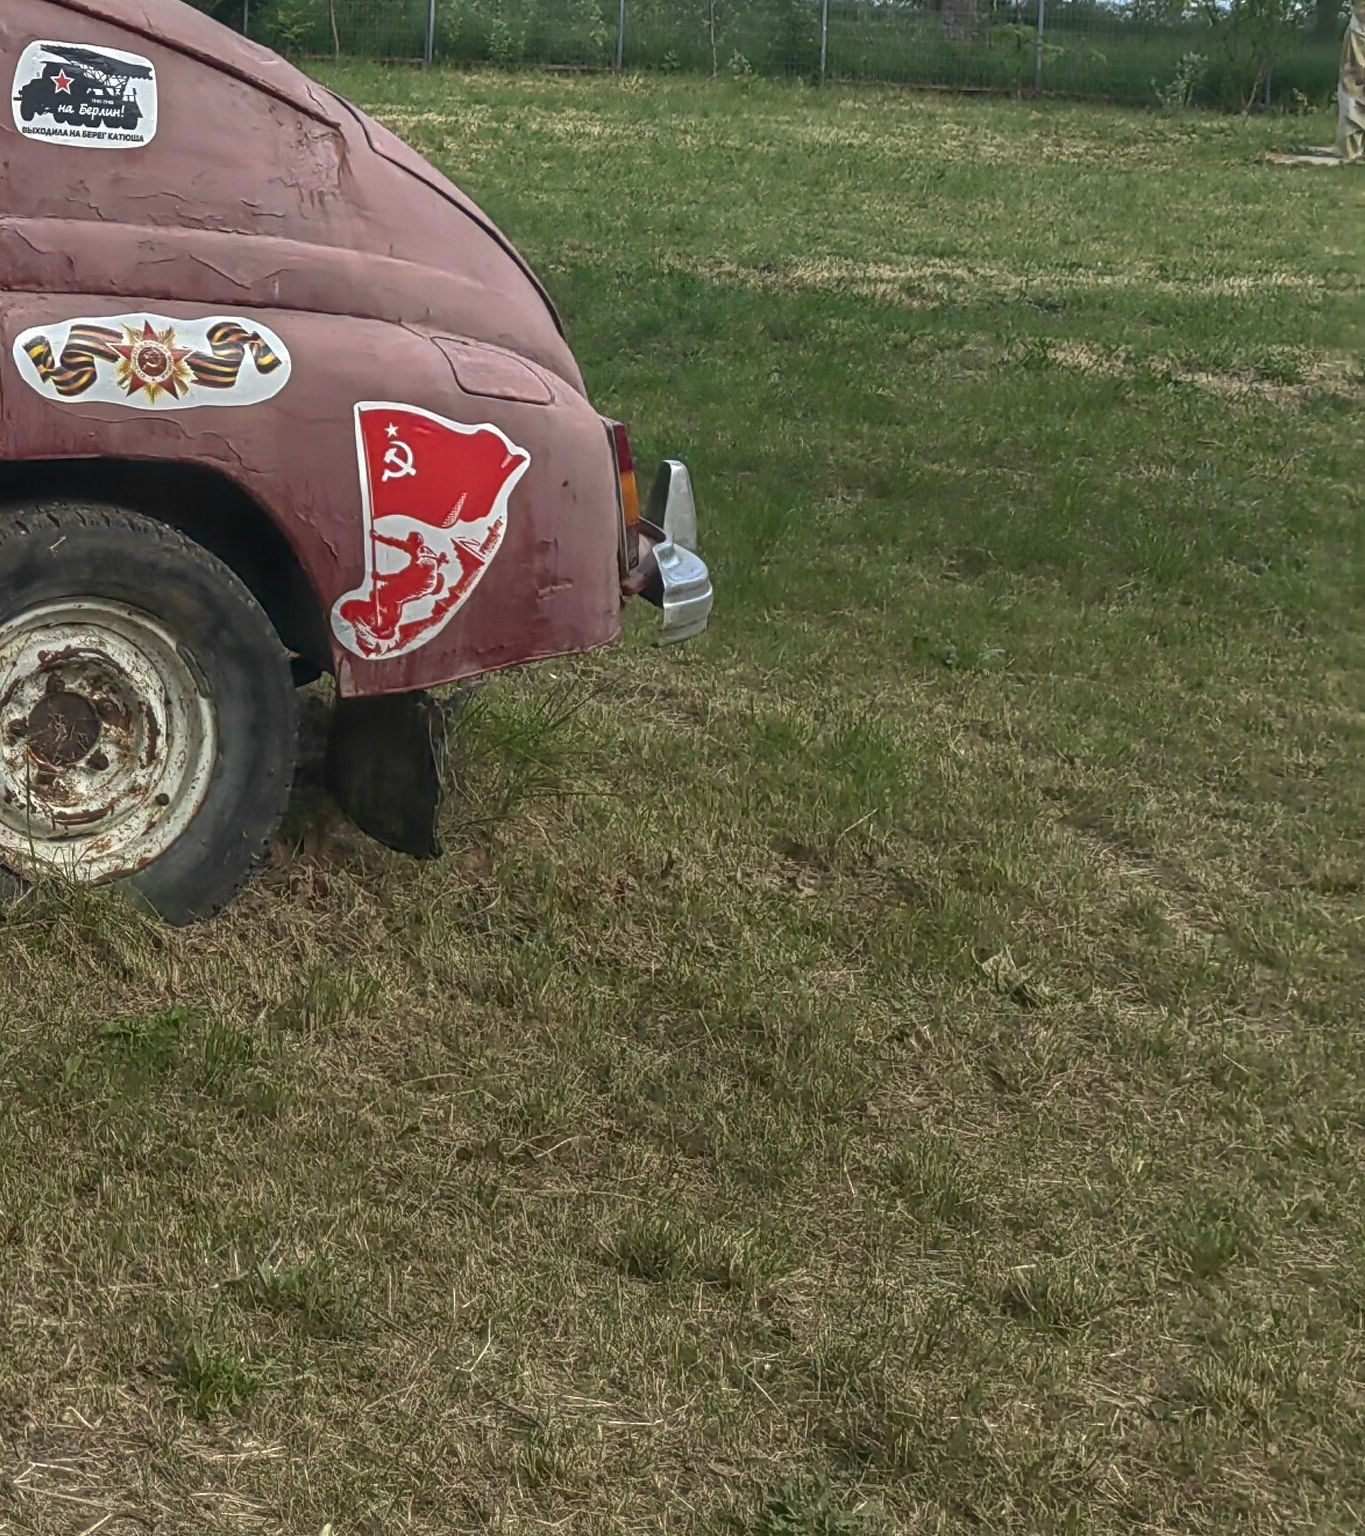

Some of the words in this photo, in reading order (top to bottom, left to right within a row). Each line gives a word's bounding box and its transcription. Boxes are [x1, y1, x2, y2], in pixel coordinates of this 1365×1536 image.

[57, 104, 75, 114] на
[79, 103, 126, 120] Берлин!
[21, 126, 69, 137] ВЫХОДИЛА
[69, 129, 81, 138] НА
[82, 130, 107, 140] БЕРЕГ
[108, 132, 145, 143] КАТЮША
